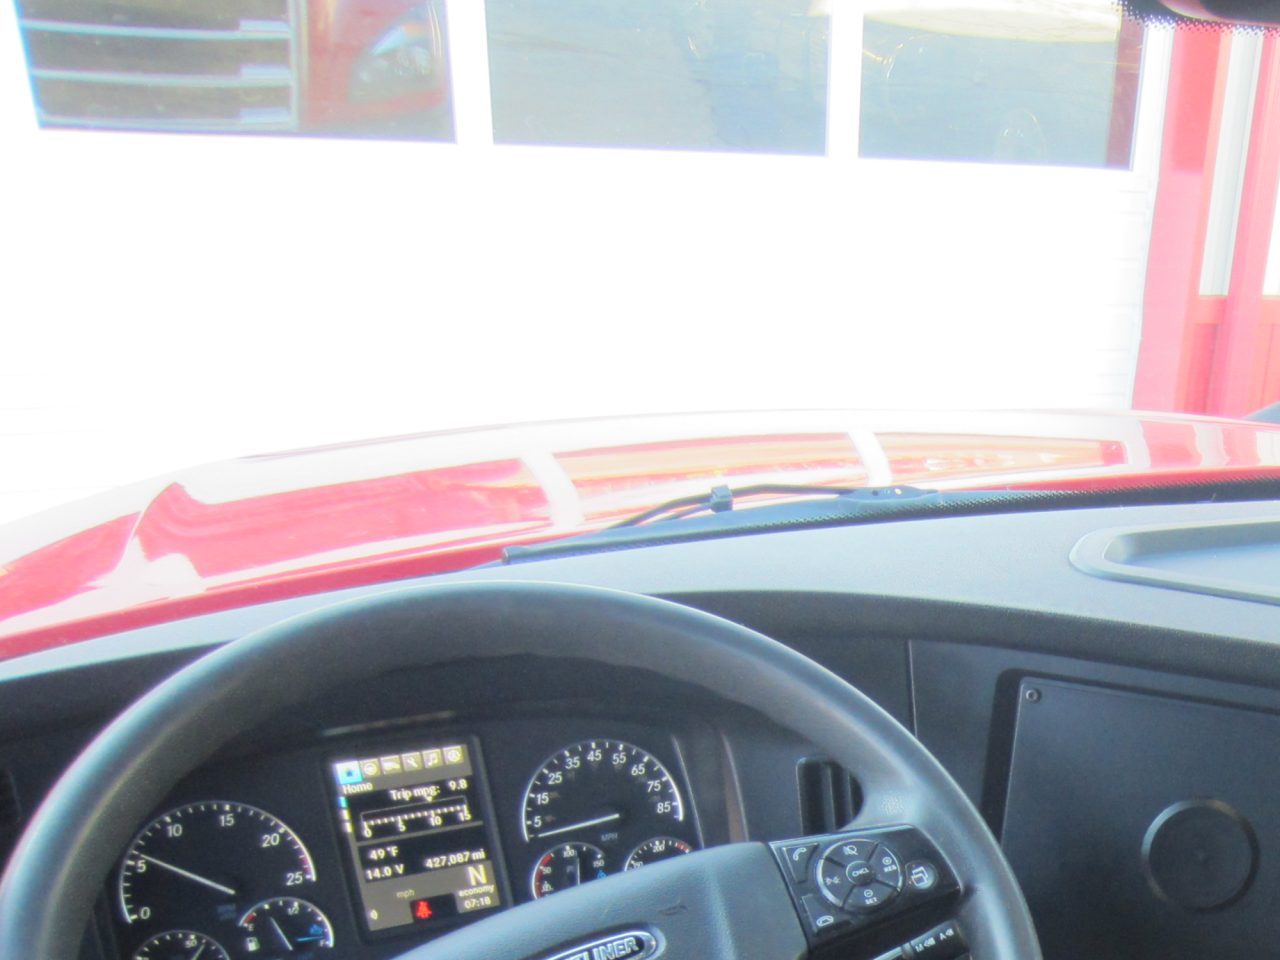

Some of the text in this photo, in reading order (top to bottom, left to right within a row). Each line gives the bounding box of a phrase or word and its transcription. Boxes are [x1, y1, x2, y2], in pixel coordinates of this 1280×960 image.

[587, 750, 602, 761] 45
[612, 752, 626, 764] 55
[565, 757, 581, 770] 35
[631, 764, 646, 776] 65
[548, 772, 563, 785] 25
[342, 782, 373, 795] Home
[390, 779, 468, 801] Trip mpg: 9.8
[647, 780, 661, 792] 75
[536, 793, 549, 805] 15
[656, 801, 671, 813] 85
[219, 814, 235, 827] 15
[534, 817, 542, 827] 5
[167, 824, 183, 837] 10
[262, 833, 280, 848] 20
[369, 849, 385, 860] 49
[472, 849, 486, 861] mi
[137, 859, 147, 873] 5
[366, 864, 405, 880] 14.0 V
[286, 872, 303, 886] 25
[468, 864, 487, 886] N
[396, 889, 415, 899] mph
[458, 885, 495, 897] economy
[140, 906, 151, 919] 0
